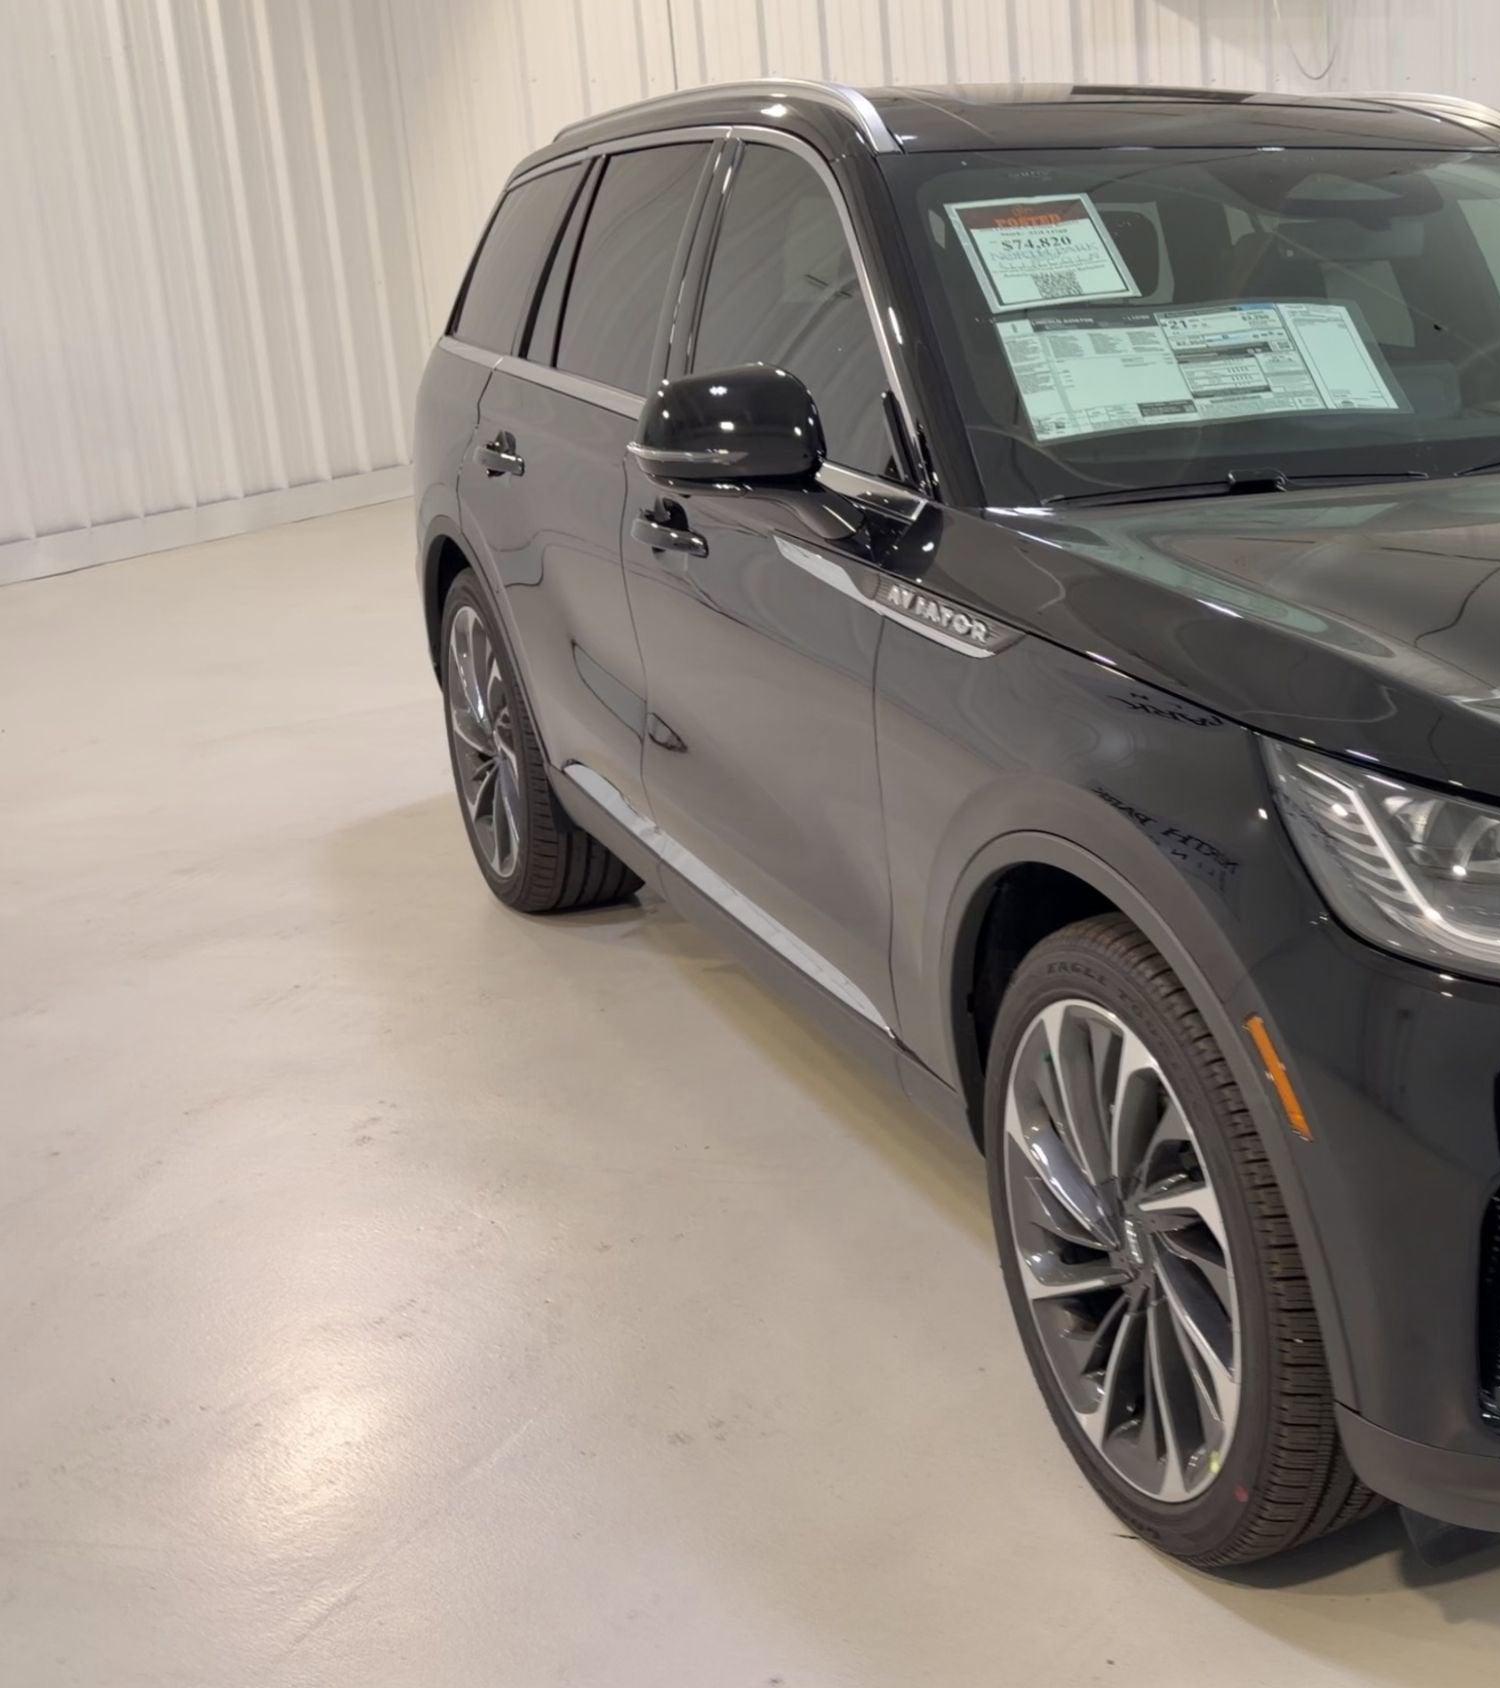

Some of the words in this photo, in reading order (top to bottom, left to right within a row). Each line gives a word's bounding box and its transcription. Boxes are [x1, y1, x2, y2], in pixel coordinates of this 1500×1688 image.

[1001, 236, 1072, 251] $74,820
[1167, 319, 1188, 330] 21
[887, 584, 990, 643] AVIATOR
